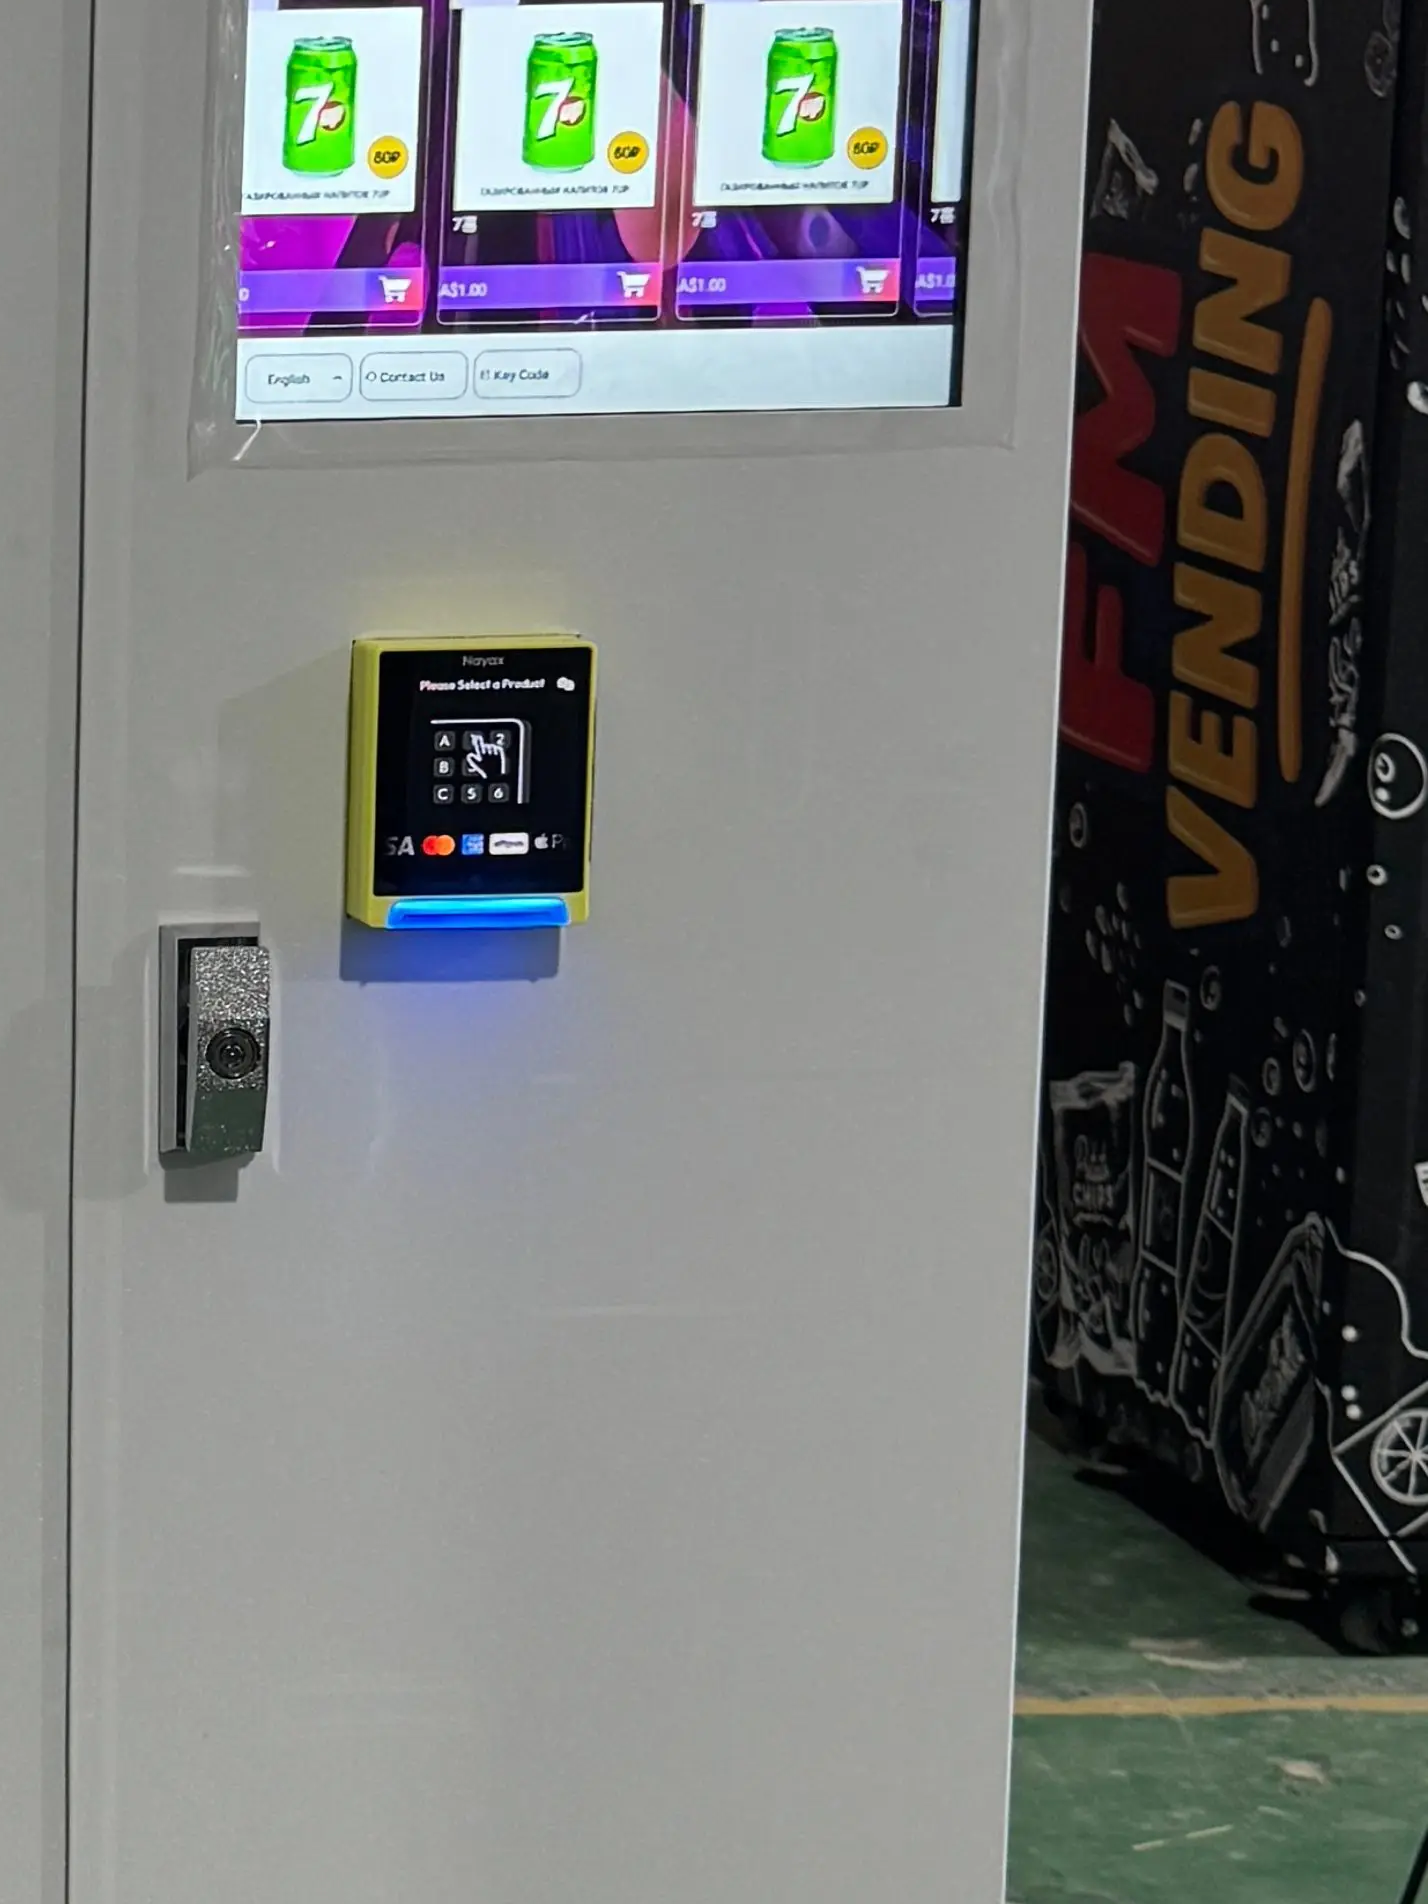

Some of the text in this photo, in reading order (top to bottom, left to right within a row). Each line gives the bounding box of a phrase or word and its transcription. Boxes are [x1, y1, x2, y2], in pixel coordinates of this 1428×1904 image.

[380, 371, 445, 383] Contact Us
[493, 368, 550, 383] Key Code
[1162, 99, 1305, 932] VENDING
[462, 655, 505, 668] Nayax
[419, 680, 456, 692] Please
[457, 679, 491, 691] Select
[502, 678, 546, 690] Product
[439, 735, 450, 747] A
[437, 787, 504, 800] C 5 6
